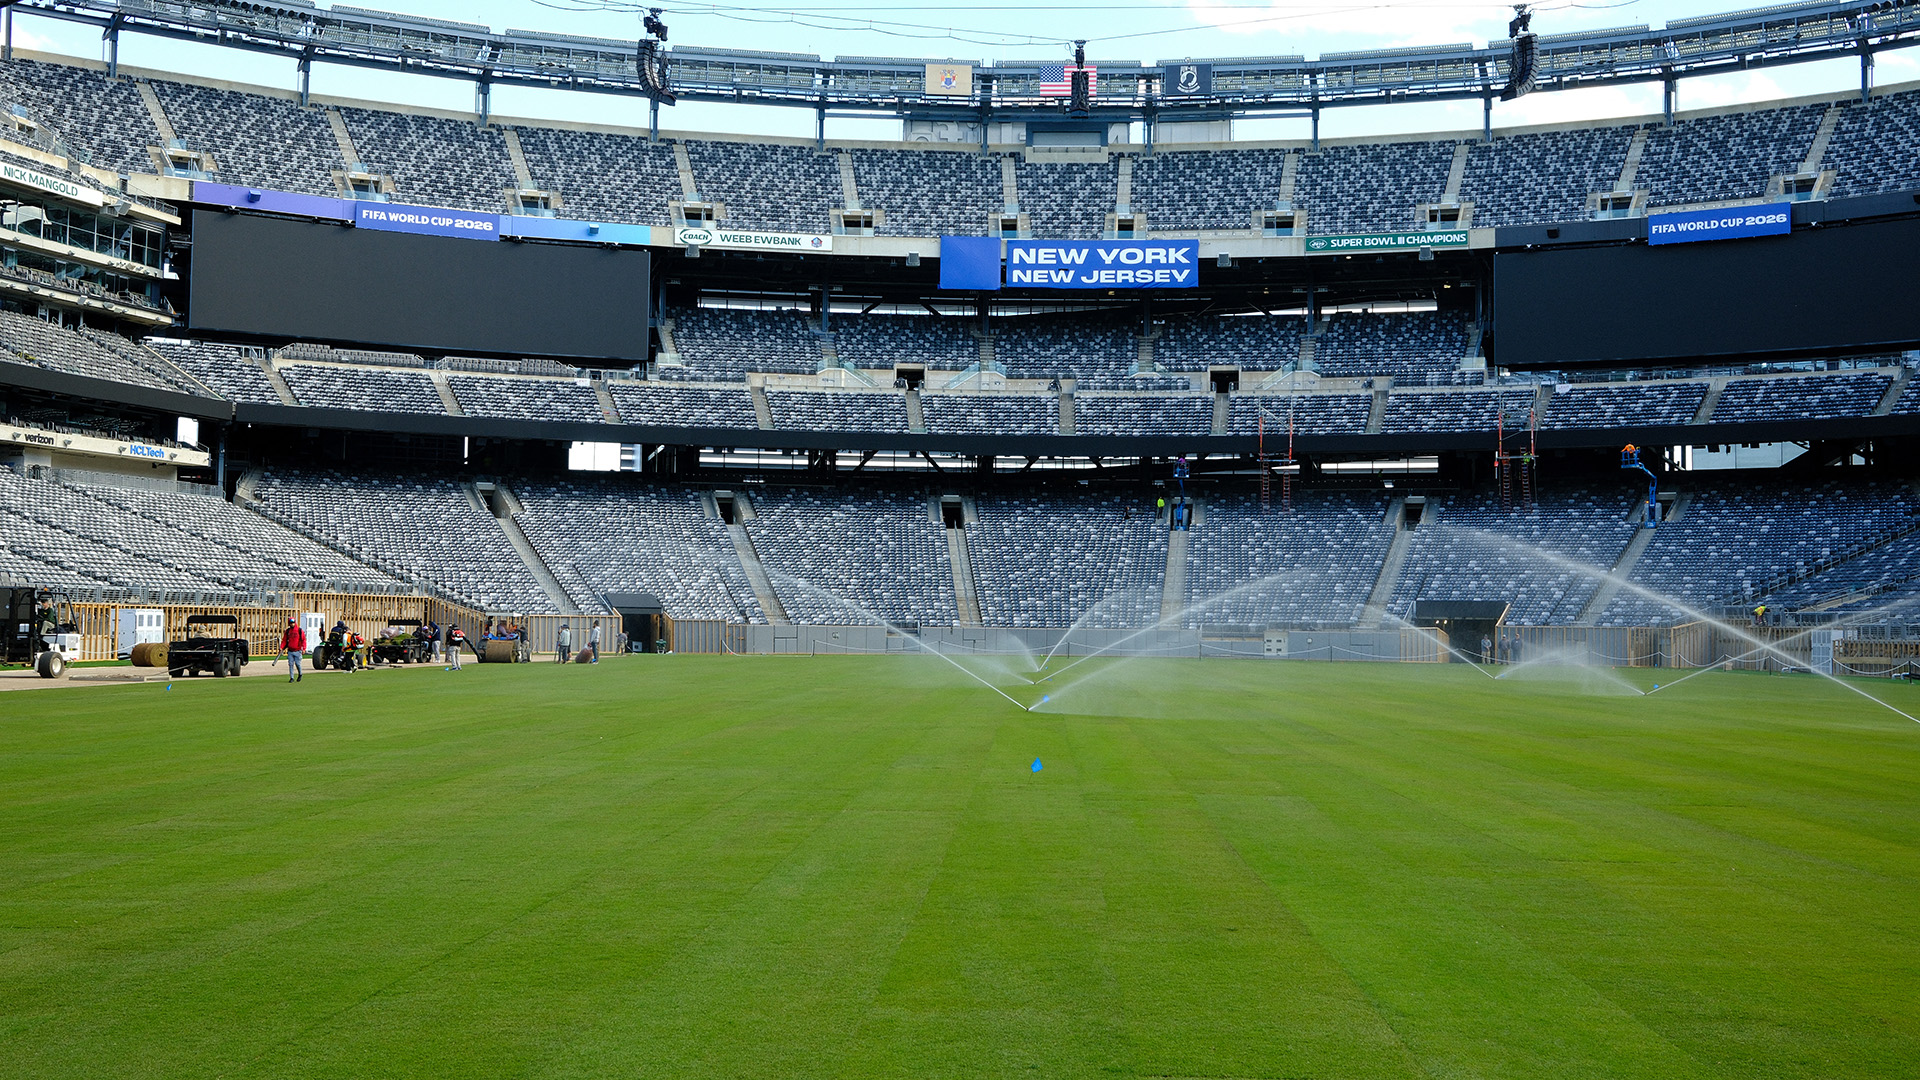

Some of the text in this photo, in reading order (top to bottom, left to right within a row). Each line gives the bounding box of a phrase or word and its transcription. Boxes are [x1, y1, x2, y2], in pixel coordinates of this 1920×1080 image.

[3, 165, 79, 197] NICK MANGOLD
[362, 209, 494, 231] FIFA WORLD CUP 2026
[1651, 213, 1788, 234] FIFA WORLD CUP 2026
[683, 233, 709, 241] COACH
[719, 233, 802, 246] WEEB EWBANK
[1330, 238, 1363, 248] SUPER
[1364, 236, 1397, 246] BOWL
[1406, 233, 1467, 245] CHAMPIONS
[1012, 247, 1191, 265] NEW YORK
[1012, 269, 1191, 284] NEW JERSEY
[24, 433, 55, 446] verizon
[129, 444, 165, 459] HCLTech
